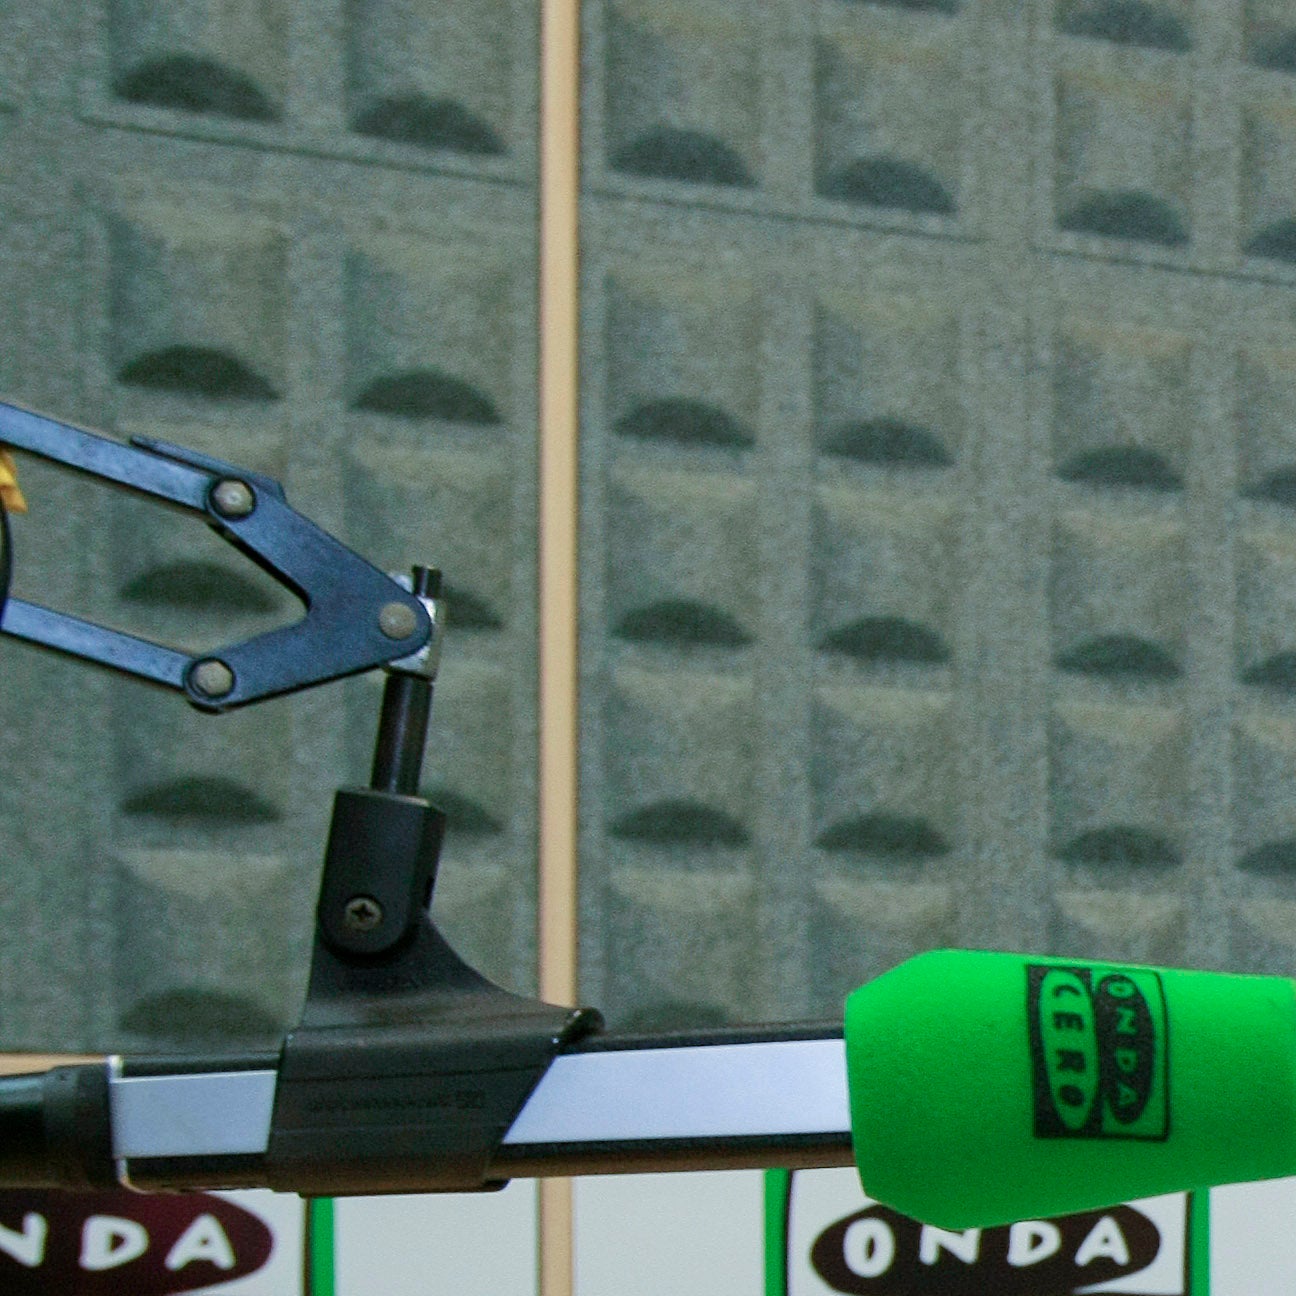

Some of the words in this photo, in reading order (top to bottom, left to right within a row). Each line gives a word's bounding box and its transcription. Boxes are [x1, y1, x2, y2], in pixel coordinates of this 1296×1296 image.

[1053, 985, 1086, 1107] CERO
[1107, 980, 1138, 1109] ONDA
[842, 1216, 1130, 1279] ONDA
